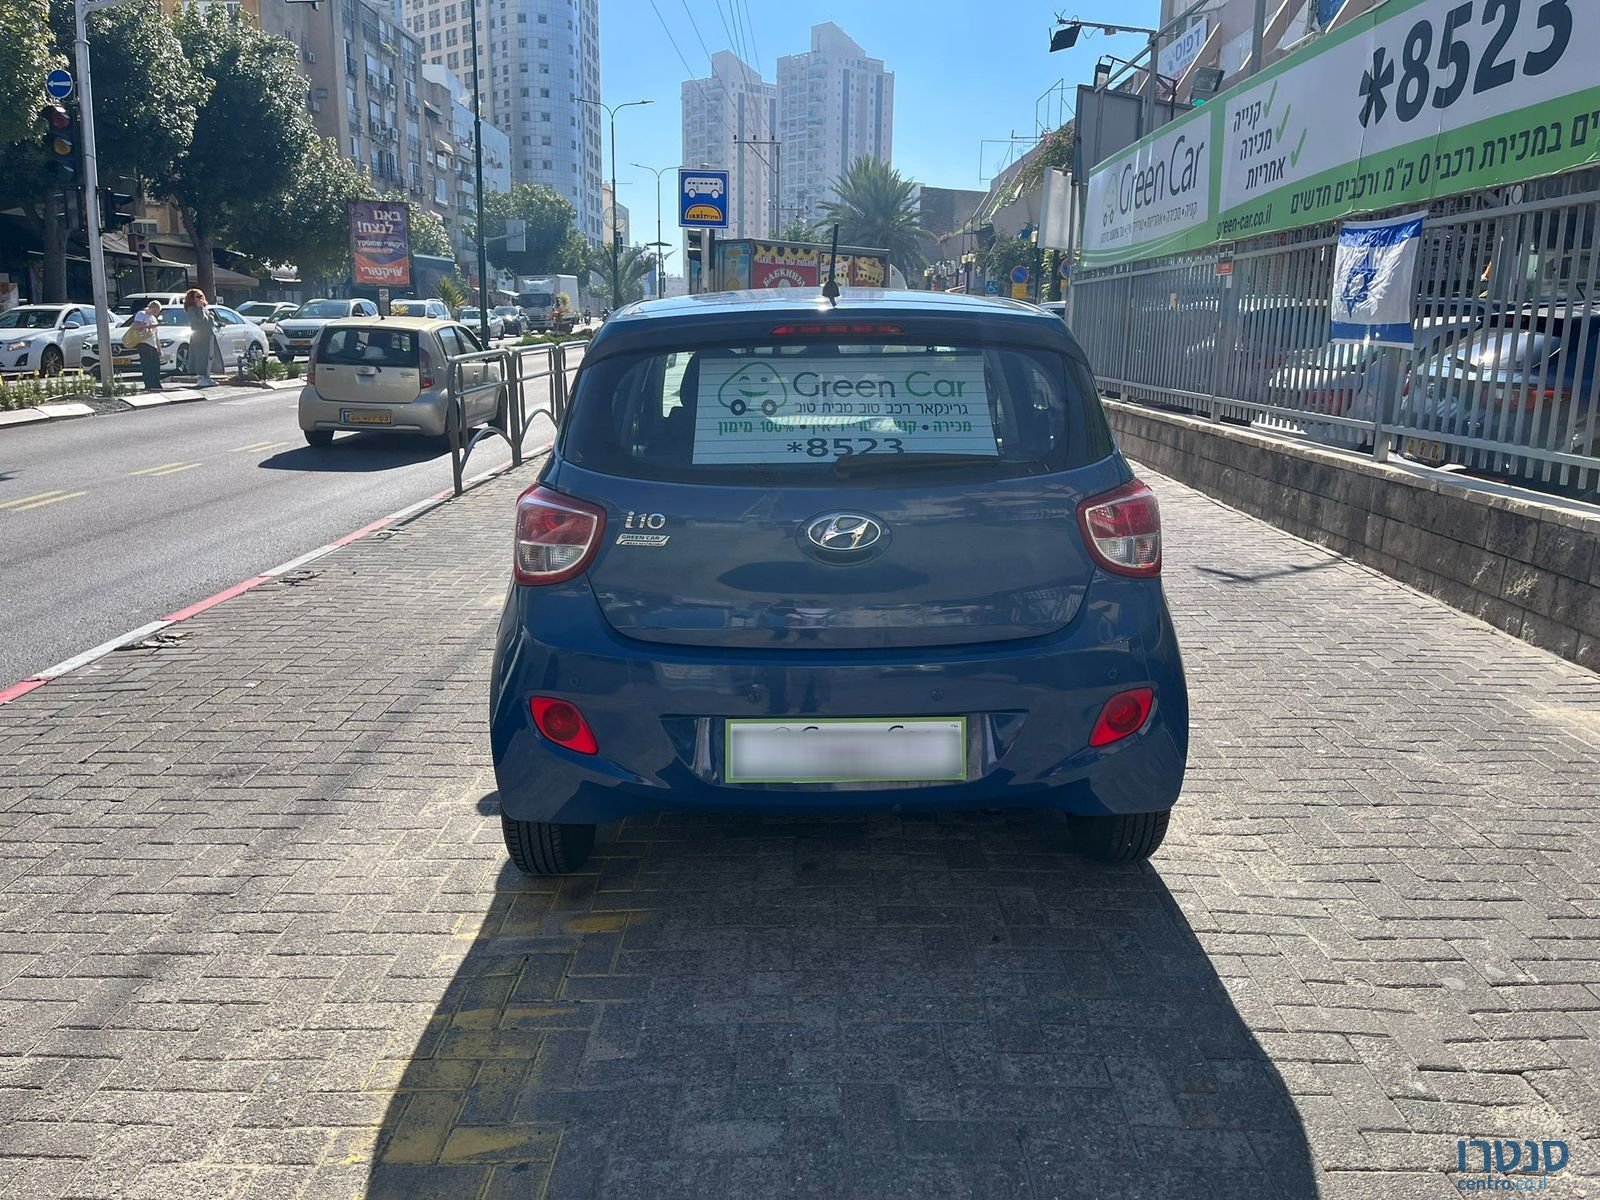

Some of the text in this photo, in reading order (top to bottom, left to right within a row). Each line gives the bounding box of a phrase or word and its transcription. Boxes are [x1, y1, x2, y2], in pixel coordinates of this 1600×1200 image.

[1175, 27, 1201, 62] דפוס
[1233, 100, 1262, 132] קנייה
[1240, 128, 1273, 161] מכירה
[1478, 121, 1562, 170] במכירת
[1120, 135, 1205, 215] Green Car
[1245, 156, 1287, 190] אחריות
[1419, 153, 1431, 184] 0
[1435, 146, 1475, 180] רכבי
[1290, 184, 1332, 214] חדשים
[1334, 170, 1380, 204] ורכבים
[357, 221, 394, 234] לנצח!
[373, 209, 402, 221] באנו
[1216, 203, 1273, 240] green-car.co.il
[763, 267, 806, 288] БАБКИНЫ
[793, 371, 966, 398] Green Car
[795, 402, 969, 417] גרינקאר רכב טוב מבית טוב
[717, 421, 753, 436] מימון
[933, 420, 972, 432] מכירה
[624, 510, 666, 529] i10
